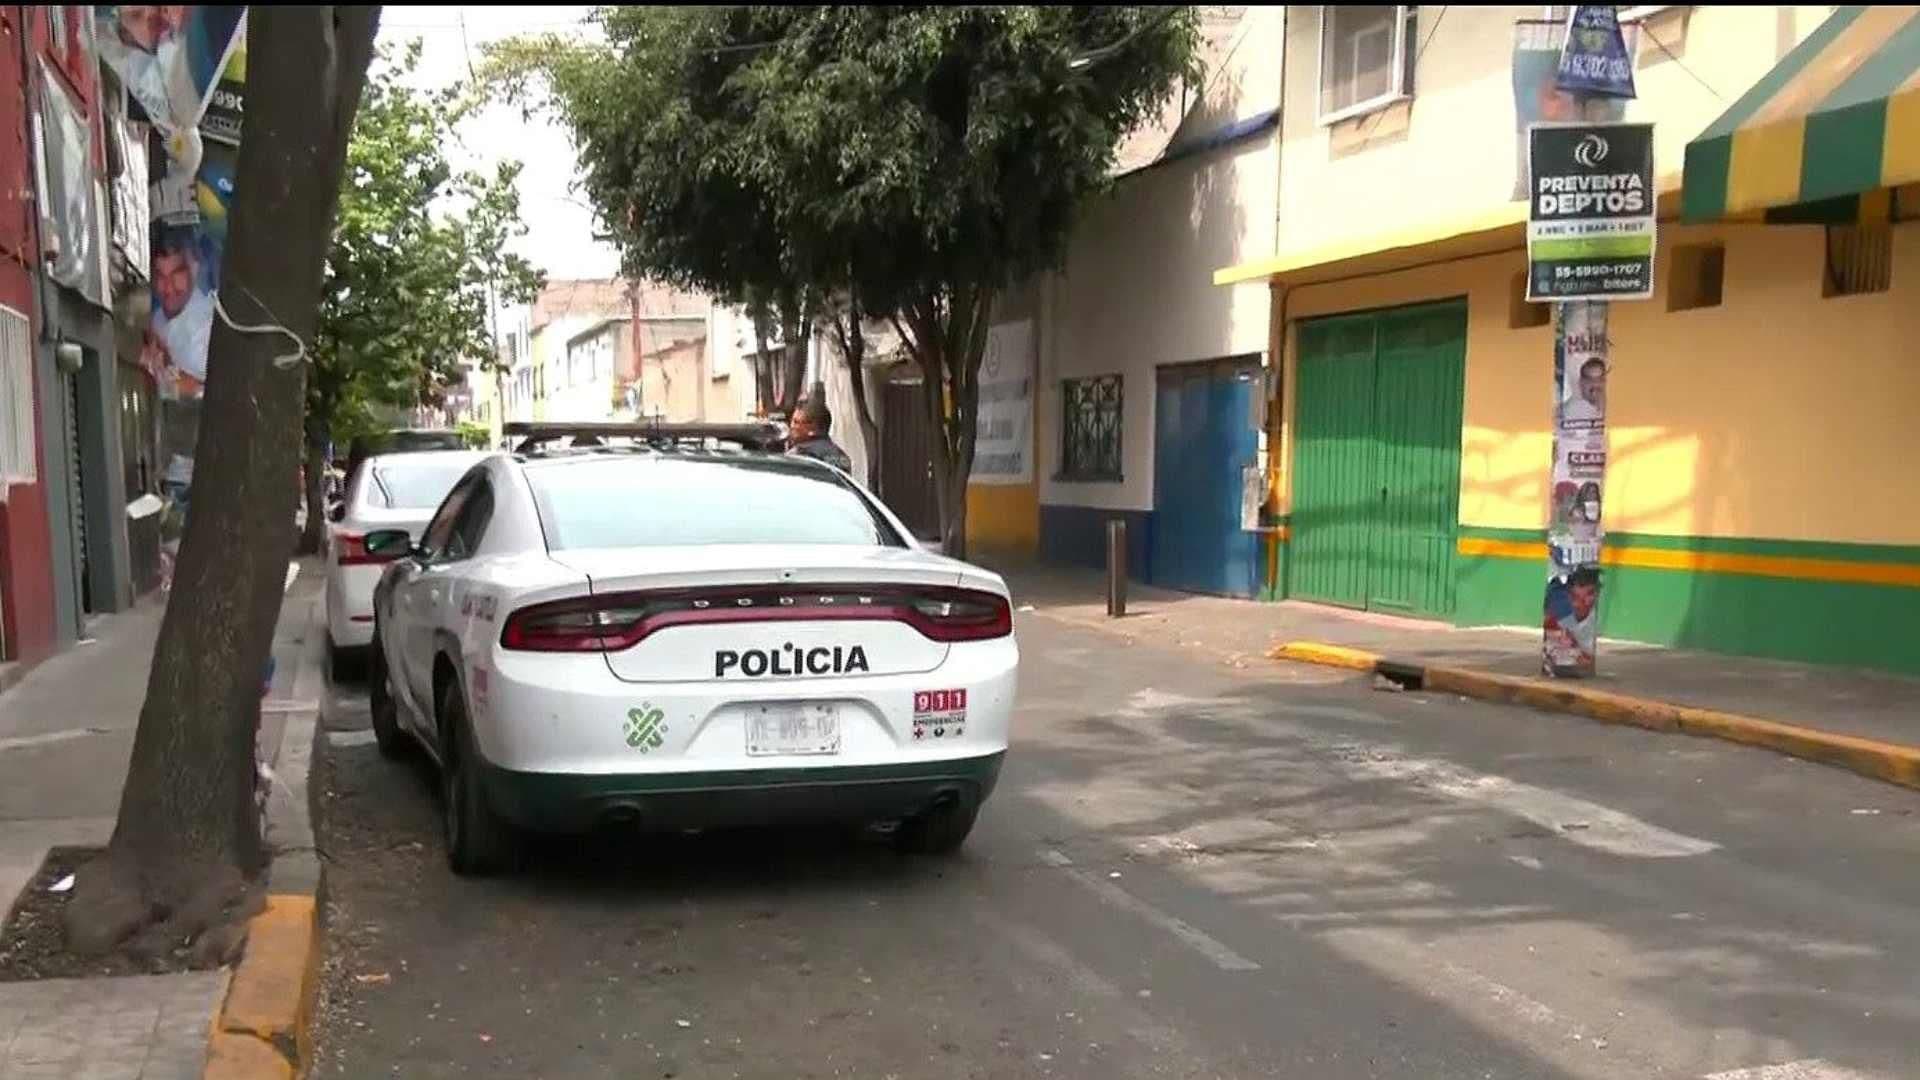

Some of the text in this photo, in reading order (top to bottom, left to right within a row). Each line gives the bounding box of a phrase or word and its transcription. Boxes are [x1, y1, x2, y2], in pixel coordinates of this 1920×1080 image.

[1539, 173, 1643, 193] PREVENTA
[1539, 190, 1644, 215] DEPTOS
[715, 644, 869, 677] POLICIA
[917, 692, 963, 710] 911
